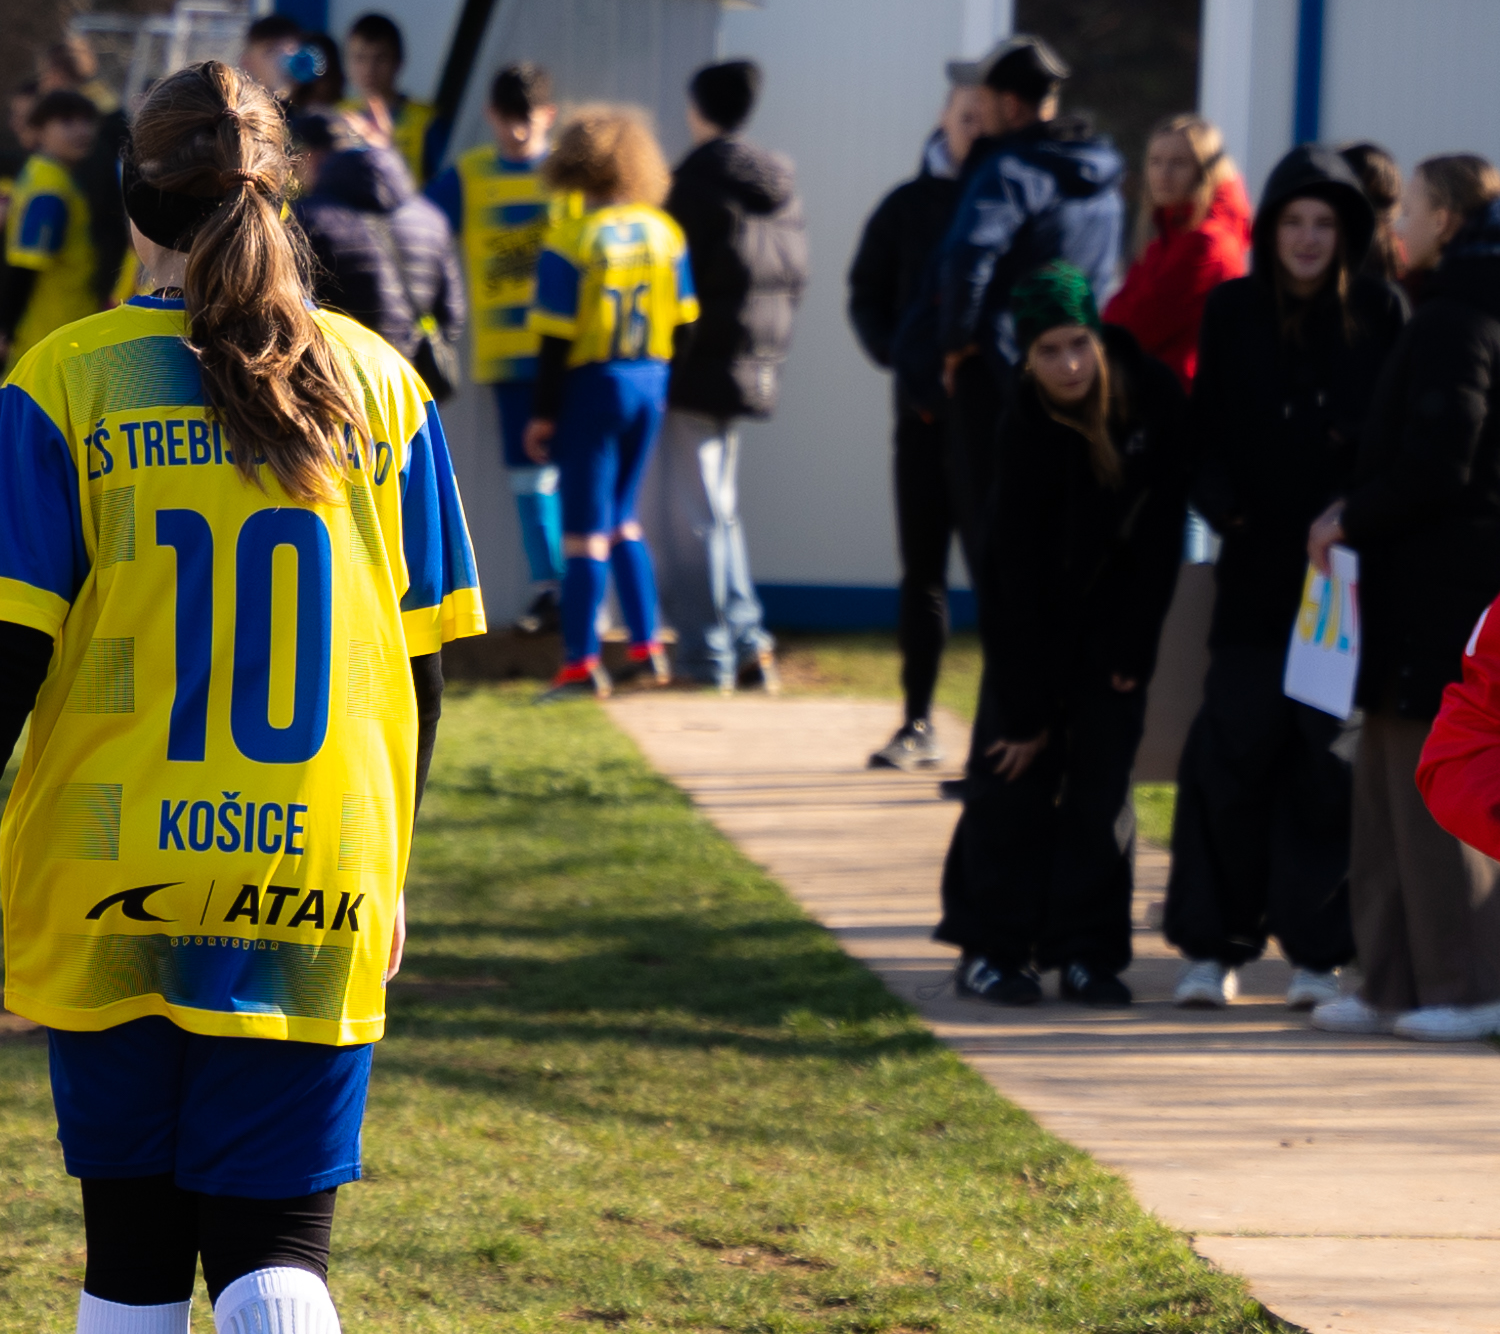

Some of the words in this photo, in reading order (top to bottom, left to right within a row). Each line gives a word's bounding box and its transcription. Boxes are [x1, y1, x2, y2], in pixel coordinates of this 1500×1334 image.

[155, 507, 333, 765] 10
[158, 791, 308, 856] KOŠICE
[223, 883, 365, 932] ATAK
